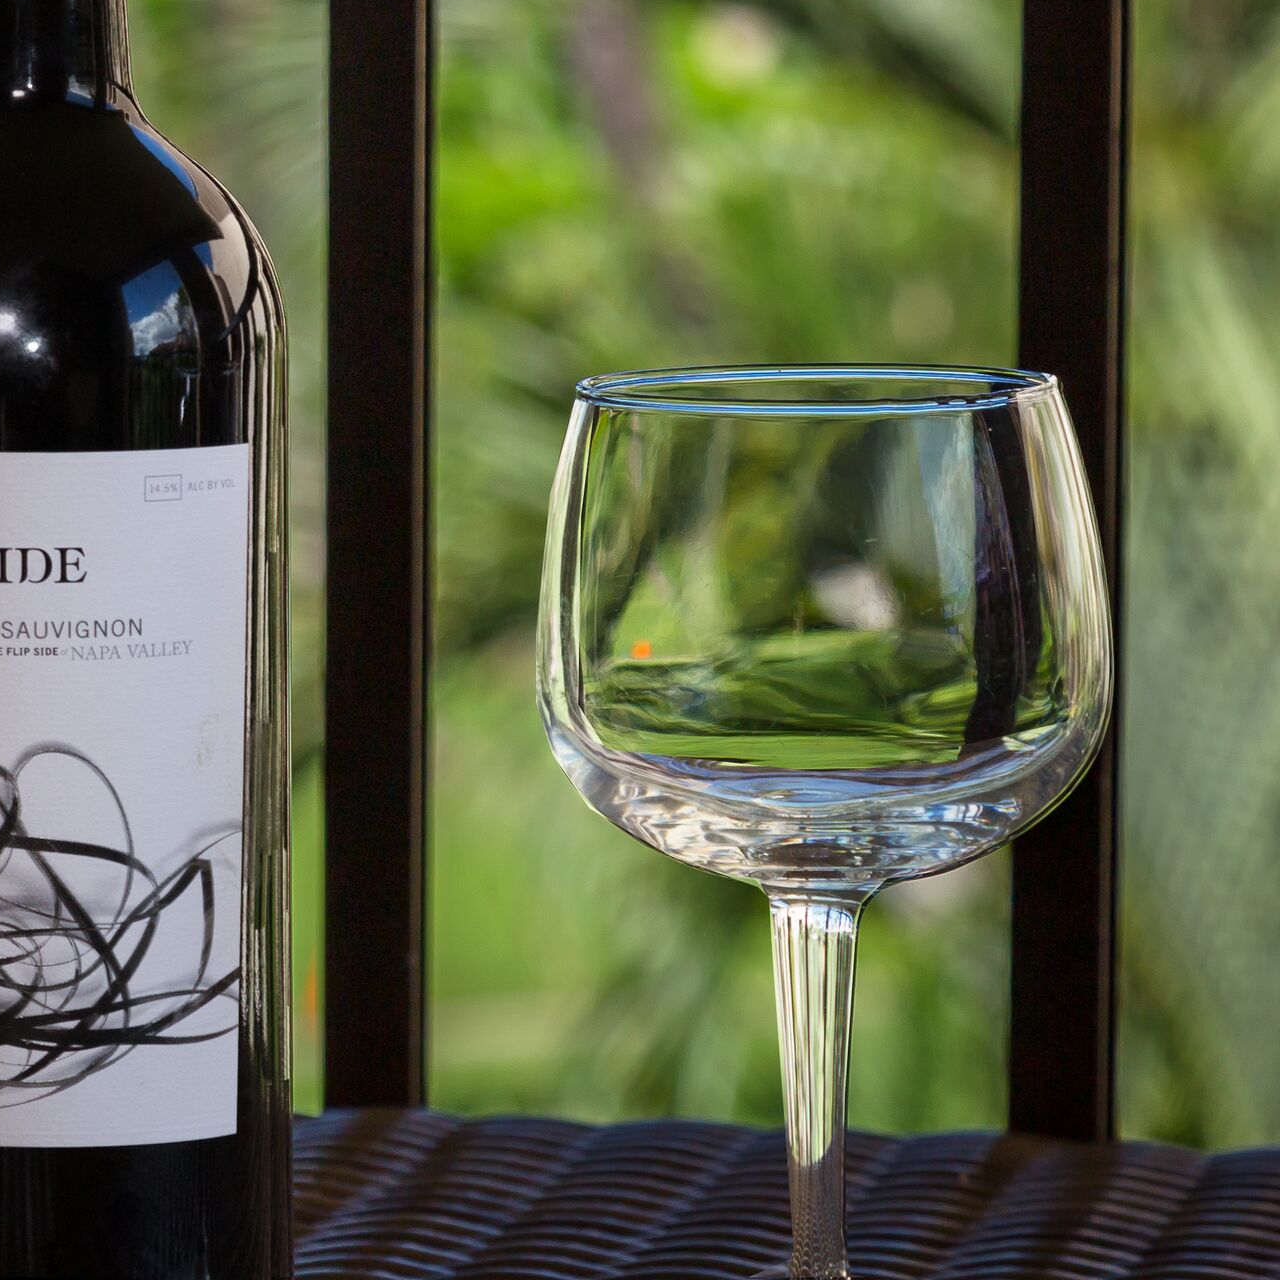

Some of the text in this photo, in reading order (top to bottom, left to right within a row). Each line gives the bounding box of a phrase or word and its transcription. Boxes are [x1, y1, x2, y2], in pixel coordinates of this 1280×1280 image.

[187, 481, 205, 493] ALC
[207, 480, 218, 491] BY
[0, 618, 144, 640] SAUVIGNON
[6, 646, 30, 657] FLIP
[33, 646, 59, 657] SIDE
[70, 645, 123, 661] NAPA
[127, 639, 194, 659] VALLEY
